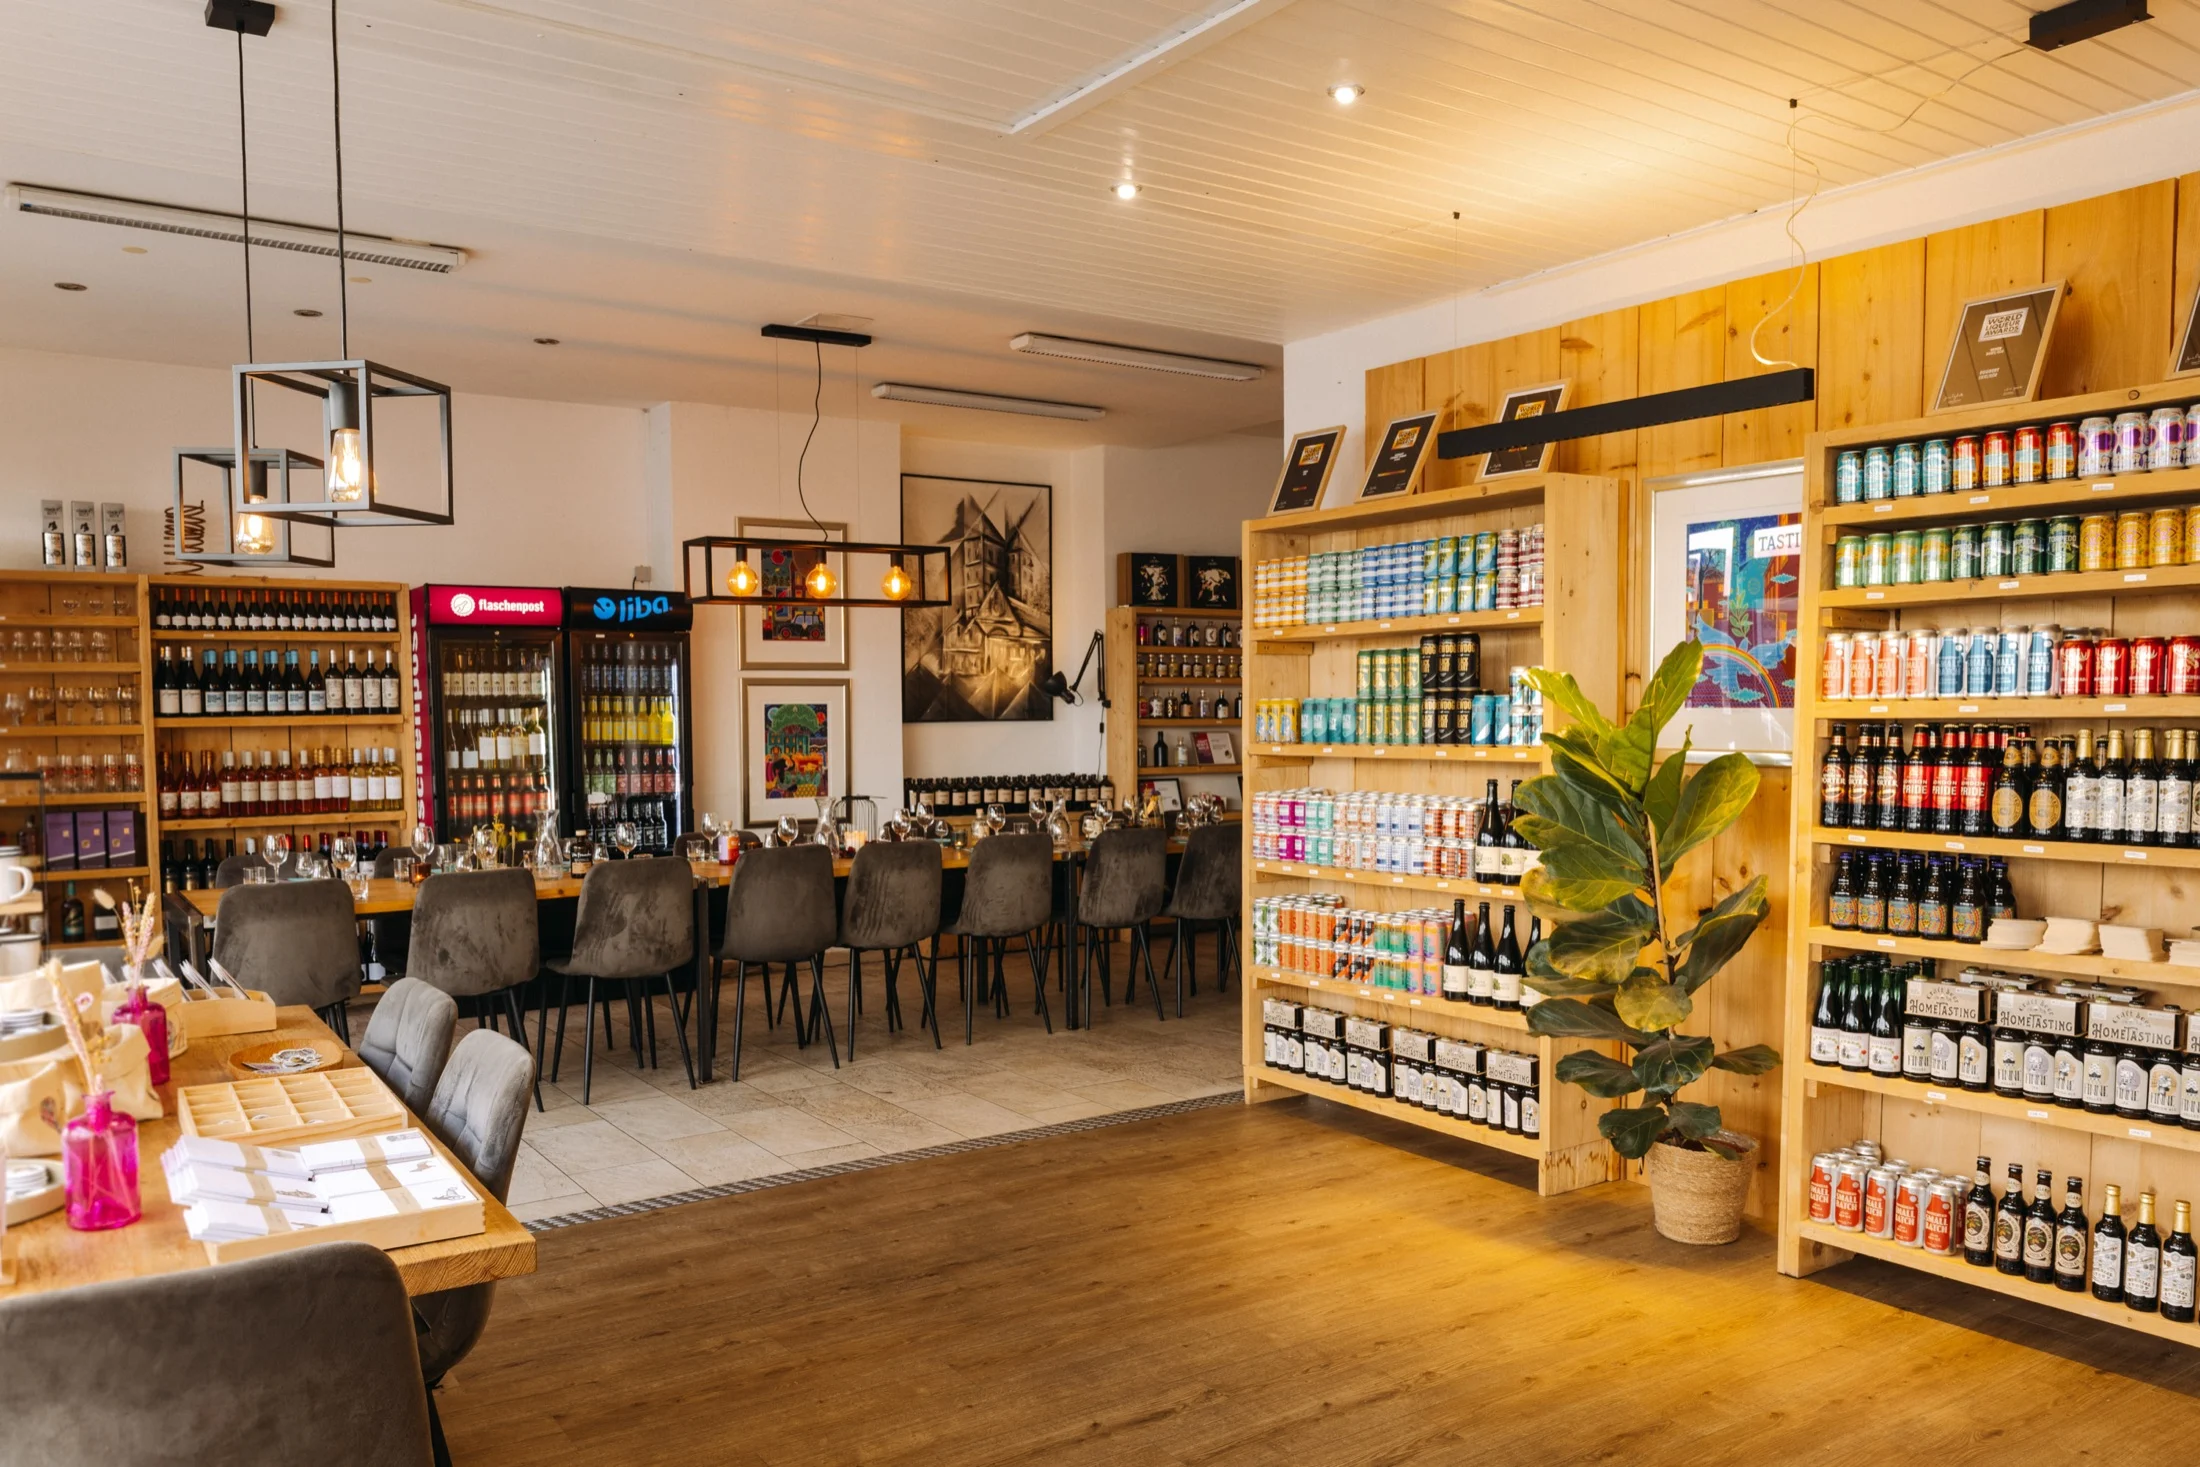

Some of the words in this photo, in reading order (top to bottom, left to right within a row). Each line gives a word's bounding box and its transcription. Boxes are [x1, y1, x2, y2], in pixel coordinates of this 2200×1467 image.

[1988, 314, 2023, 325] WORLD
[1985, 320, 2021, 331] LIQUEUR
[1983, 327, 2019, 337] AWARDS
[1758, 532, 1800, 551] TASTI
[478, 599, 545, 615] flaschenpost
[1903, 785, 1928, 795] PRIDE
[1837, 1192, 1858, 1203] SMALL
[1836, 1201, 1858, 1211] BATCH
[1925, 1213, 1949, 1226] SMALL
[1925, 1222, 1948, 1234] BATCH
